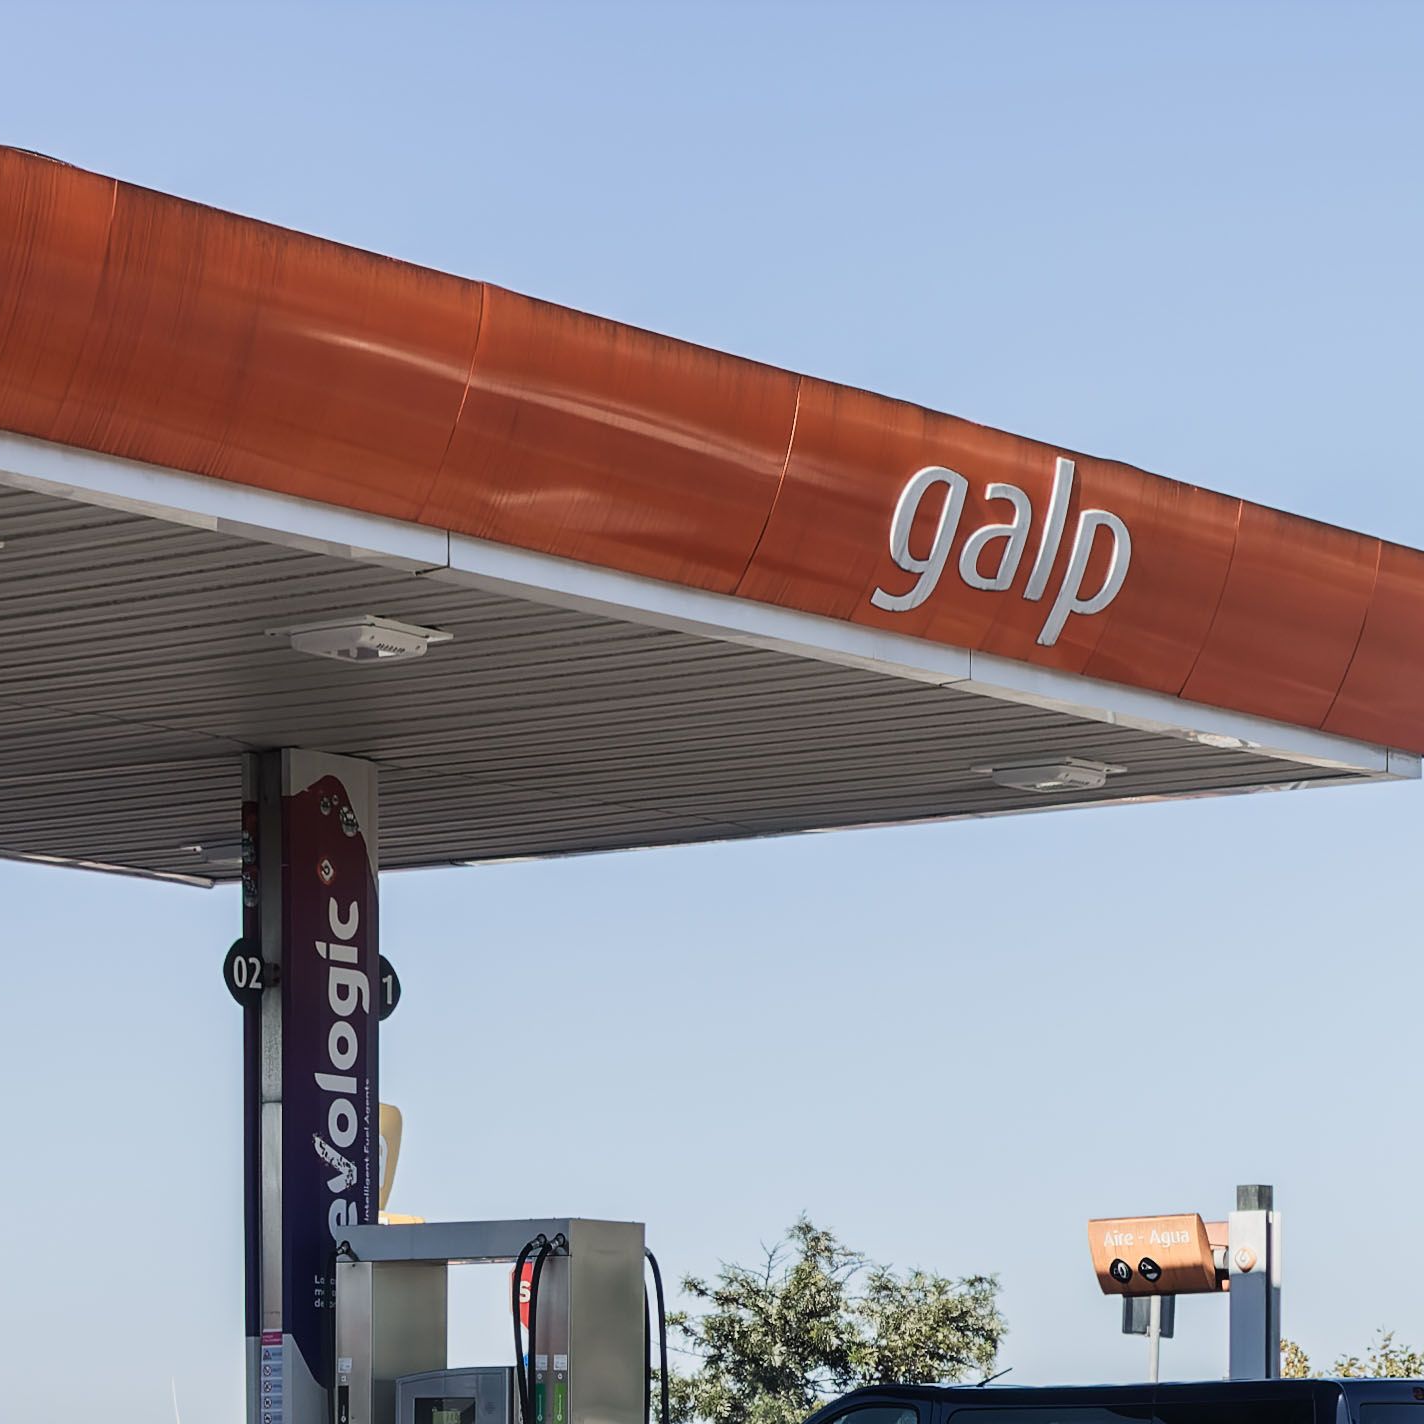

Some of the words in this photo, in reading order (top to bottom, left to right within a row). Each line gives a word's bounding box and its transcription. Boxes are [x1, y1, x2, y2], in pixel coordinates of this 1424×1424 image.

[870, 456, 1132, 647] galp
[233, 956, 263, 989] 02
[1104, 1230, 1134, 1247] Aire
[1149, 1229, 1191, 1248] Agua
